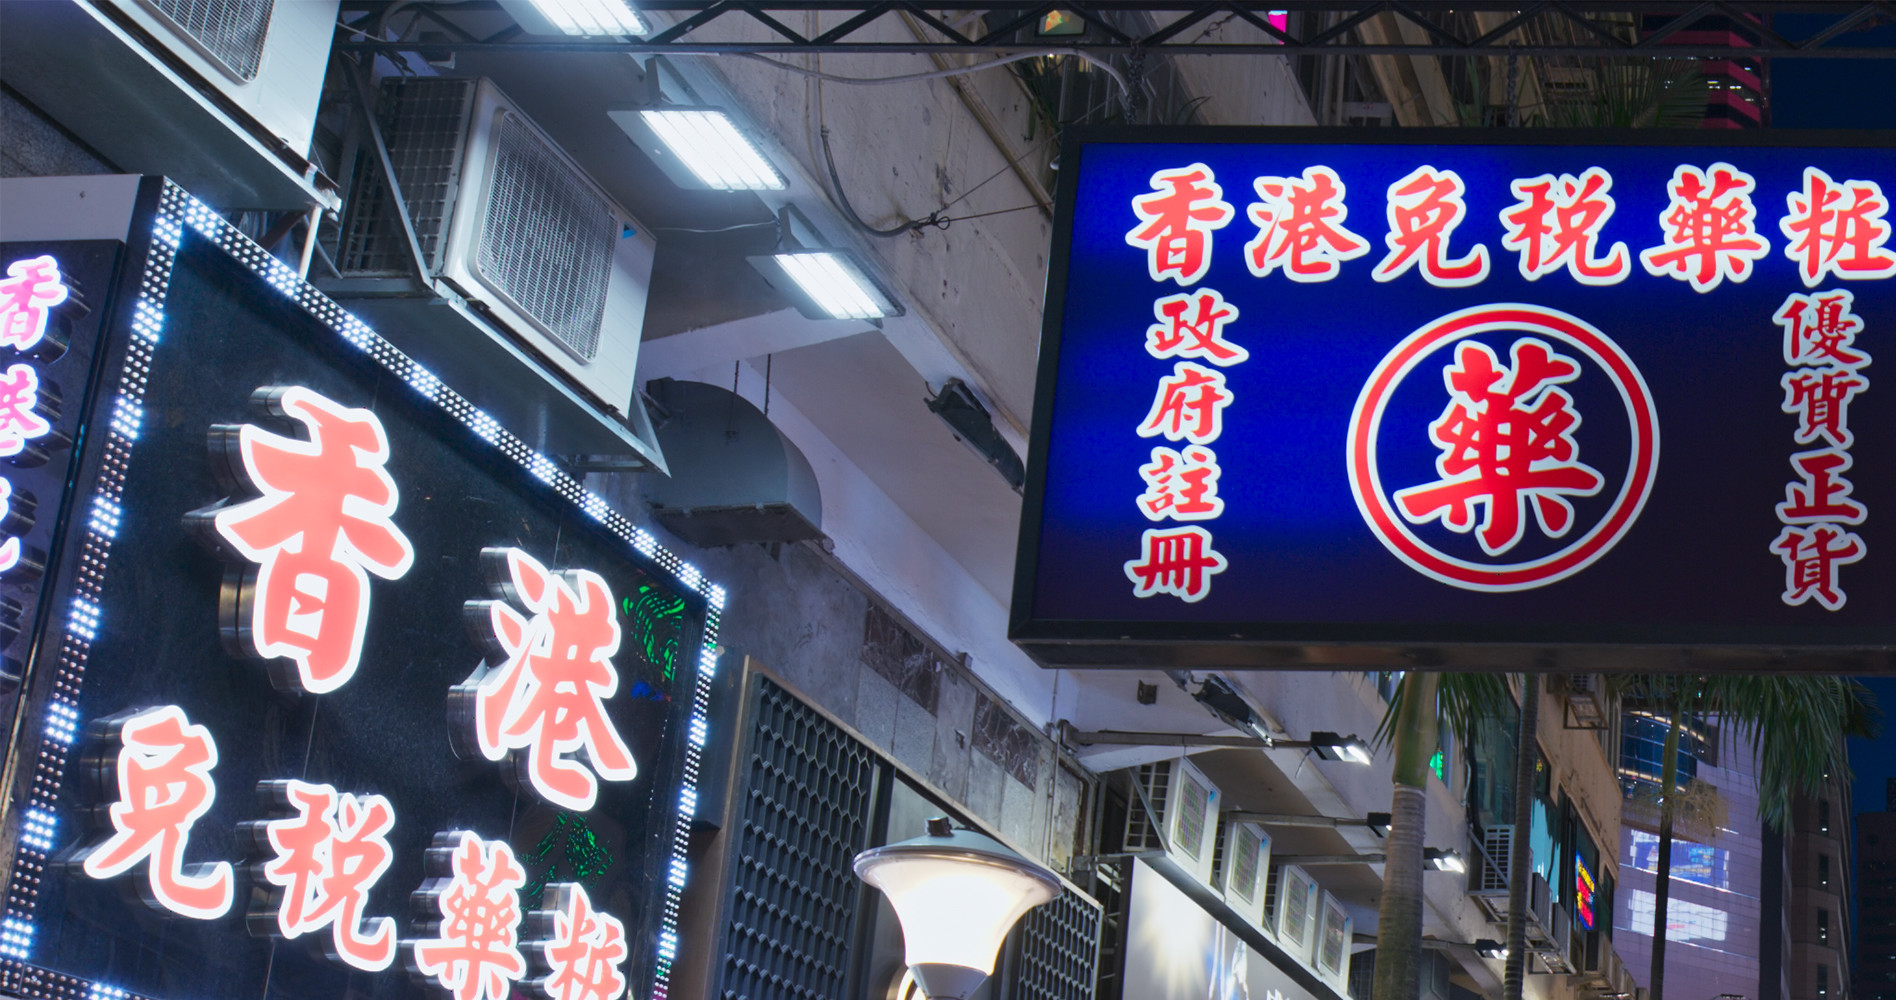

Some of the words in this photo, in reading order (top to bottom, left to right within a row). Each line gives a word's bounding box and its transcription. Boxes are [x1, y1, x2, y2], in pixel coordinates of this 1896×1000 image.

[215, 385, 637, 810] 香港
[1125, 287, 1249, 602] 政府註冊
[1394, 336, 1605, 556] 藥
[1771, 289, 1872, 611] 優質正貨
